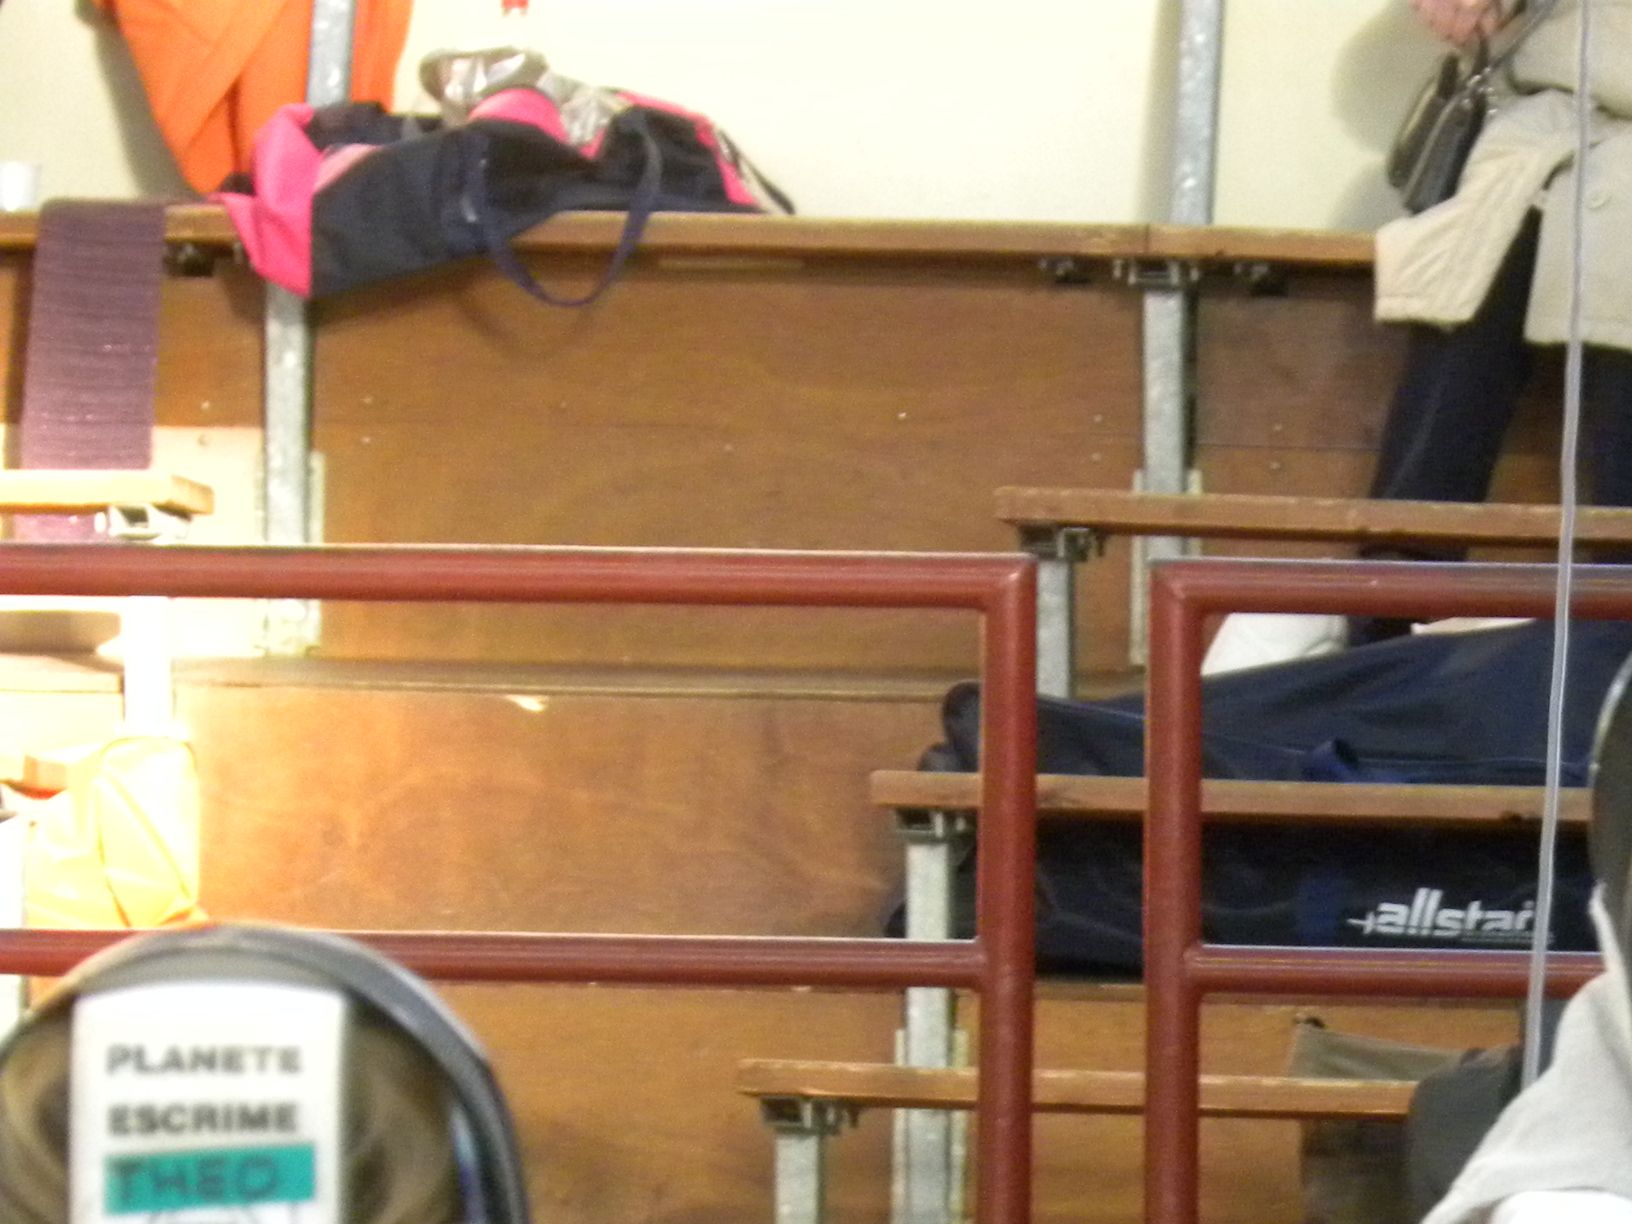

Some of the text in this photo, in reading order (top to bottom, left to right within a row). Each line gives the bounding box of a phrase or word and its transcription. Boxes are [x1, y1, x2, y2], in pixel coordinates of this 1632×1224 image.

[1374, 887, 1535, 936] allstar
[106, 1045, 301, 1075] PLANETE
[107, 1103, 298, 1135] ESCRIME
[109, 1156, 279, 1206] THEO
